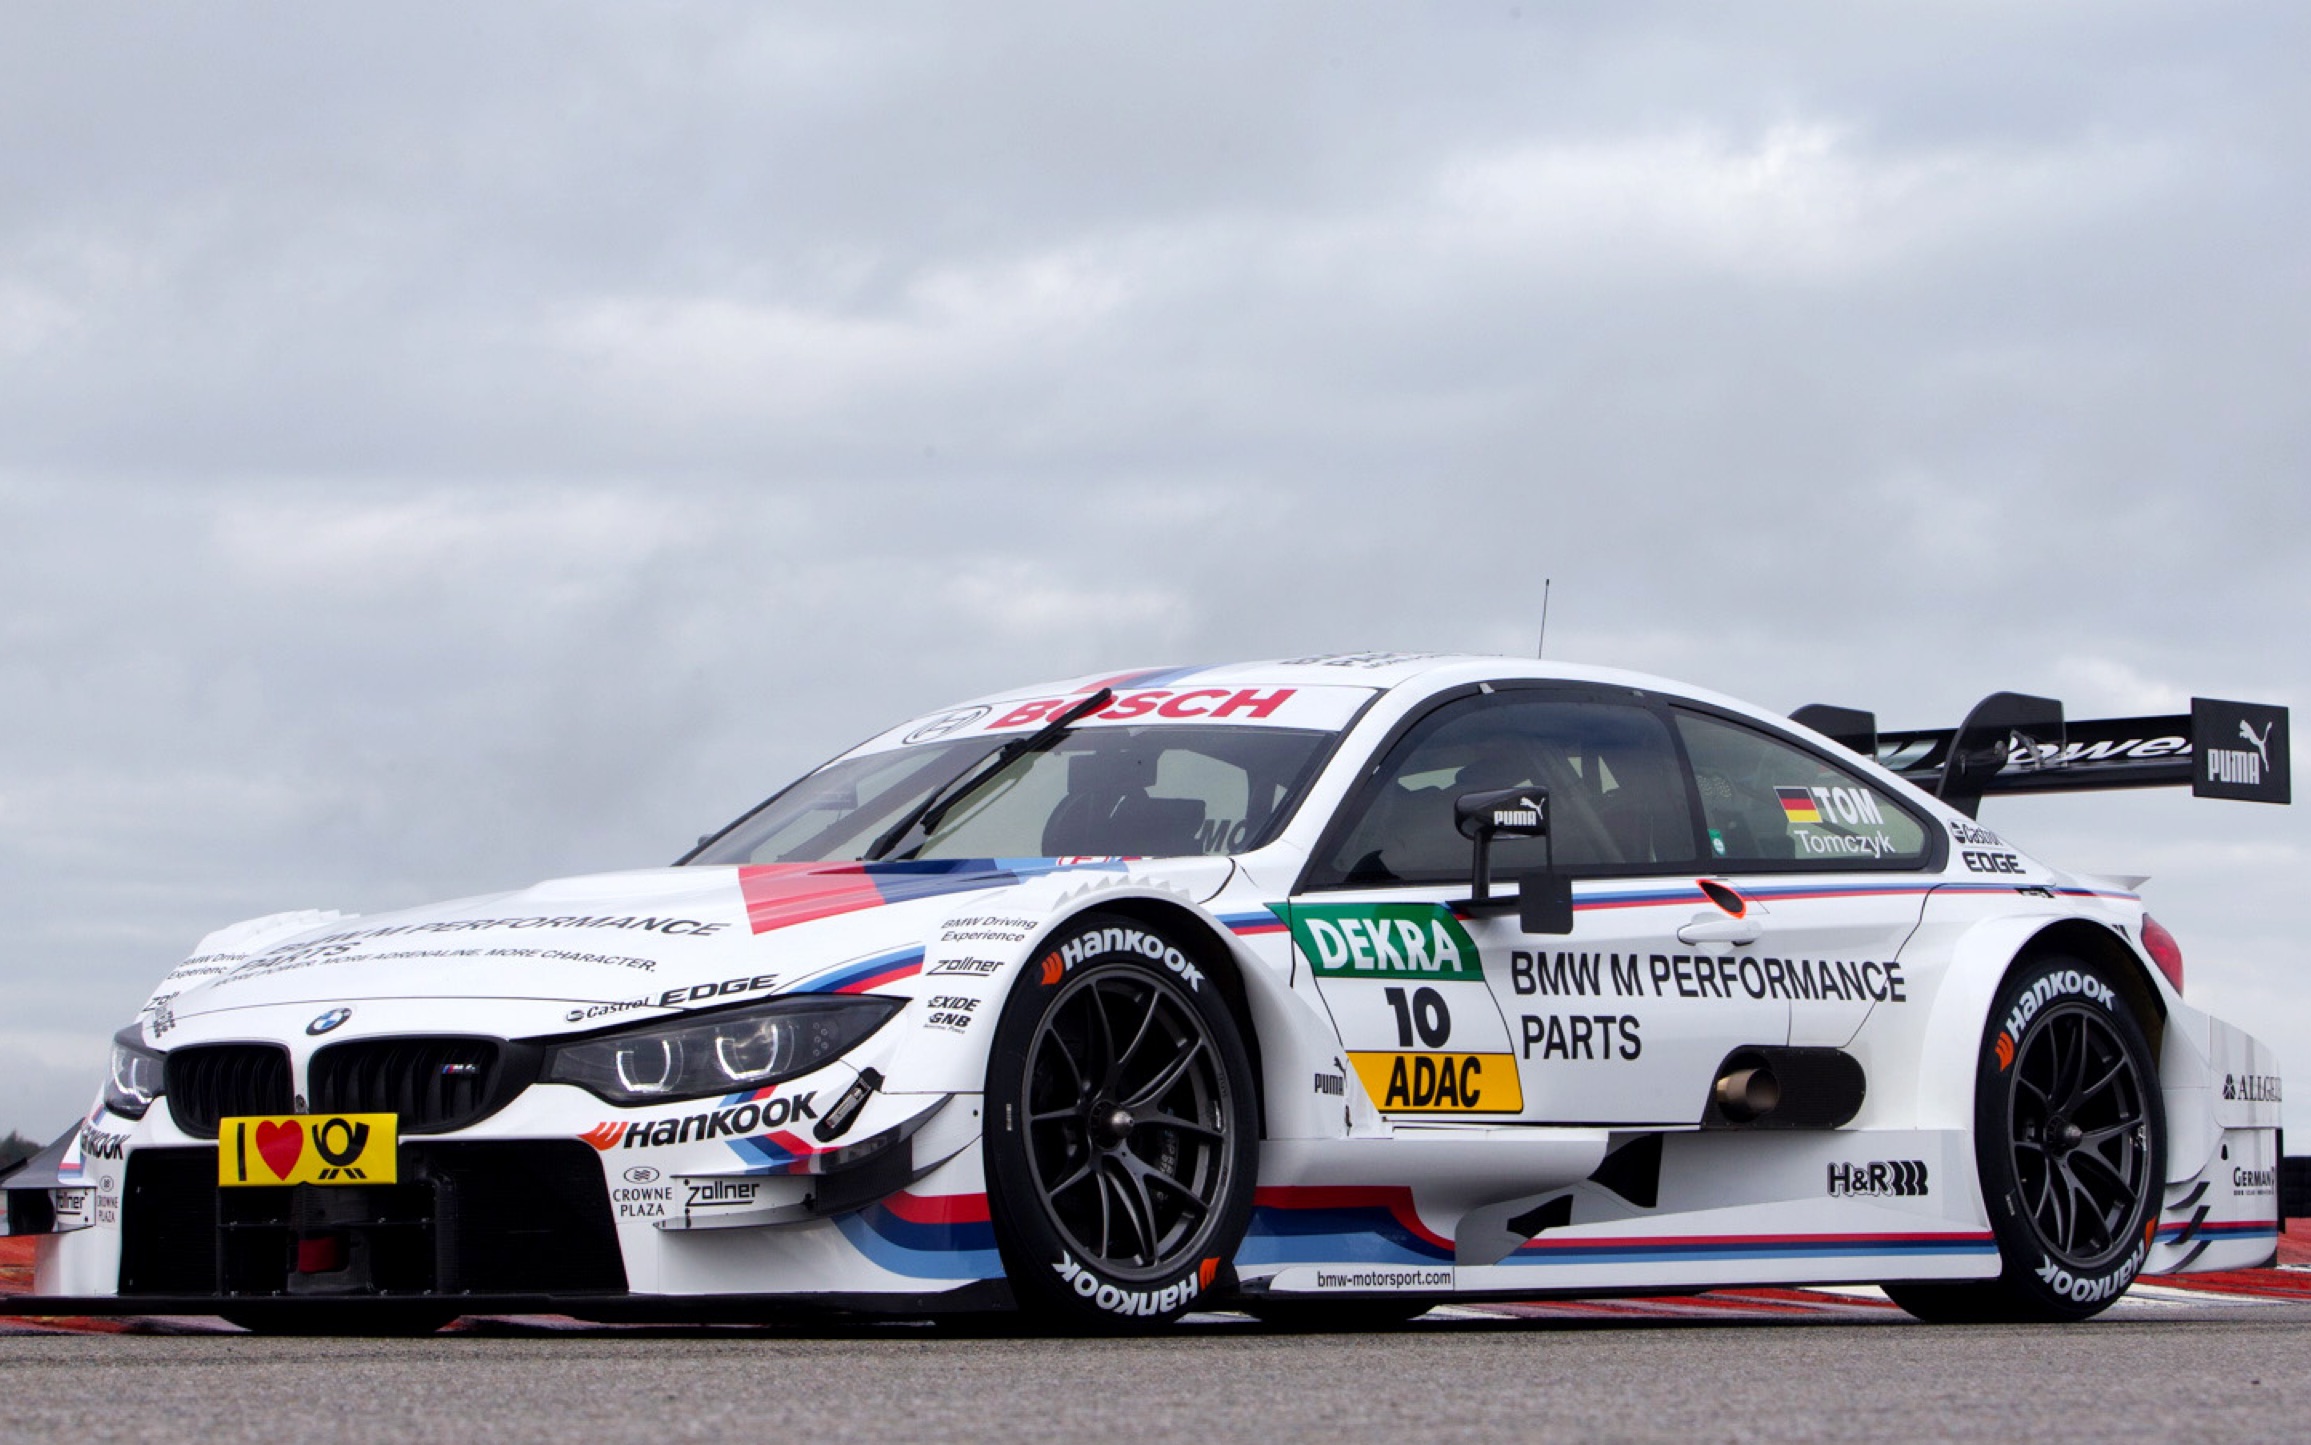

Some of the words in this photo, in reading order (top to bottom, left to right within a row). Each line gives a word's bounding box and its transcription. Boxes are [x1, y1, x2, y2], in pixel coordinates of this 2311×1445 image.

[2207, 748, 2260, 785] PUMA
[1811, 786, 1883, 825] TOM
[1494, 810, 1536, 826] PUMA
[1794, 829, 1896, 859] Tomczyk
[1962, 851, 2026, 874] EDGE
[405, 916, 732, 936] PERFORMANCE
[941, 917, 982, 929] BMW
[983, 916, 1038, 930] Driving
[941, 930, 1025, 942] Experience
[1305, 918, 1463, 972] DEKRA
[541, 948, 657, 972] CHARACTER.
[1511, 951, 1601, 996] BMW
[1610, 953, 1644, 997] M
[1650, 955, 1907, 1003] PERFORMANCE
[659, 973, 779, 1007] EDGE
[586, 996, 651, 1019] Castrol
[927, 995, 981, 1012] EXIDE
[929, 1012, 972, 1028] GNB
[1384, 986, 1451, 1048] 10
[1521, 1015, 1642, 1061] PARTS
[1315, 1073, 1345, 1096] PUMA
[1384, 1056, 1481, 1107] ADAC
[1827, 1161, 1893, 1197] H&R
[613, 1187, 673, 1201] CROWNE
[686, 1182, 761, 1207] zollner
[620, 1203, 665, 1217] PLAZA
[1317, 1270, 1451, 1289] bmw-motorsport.com
